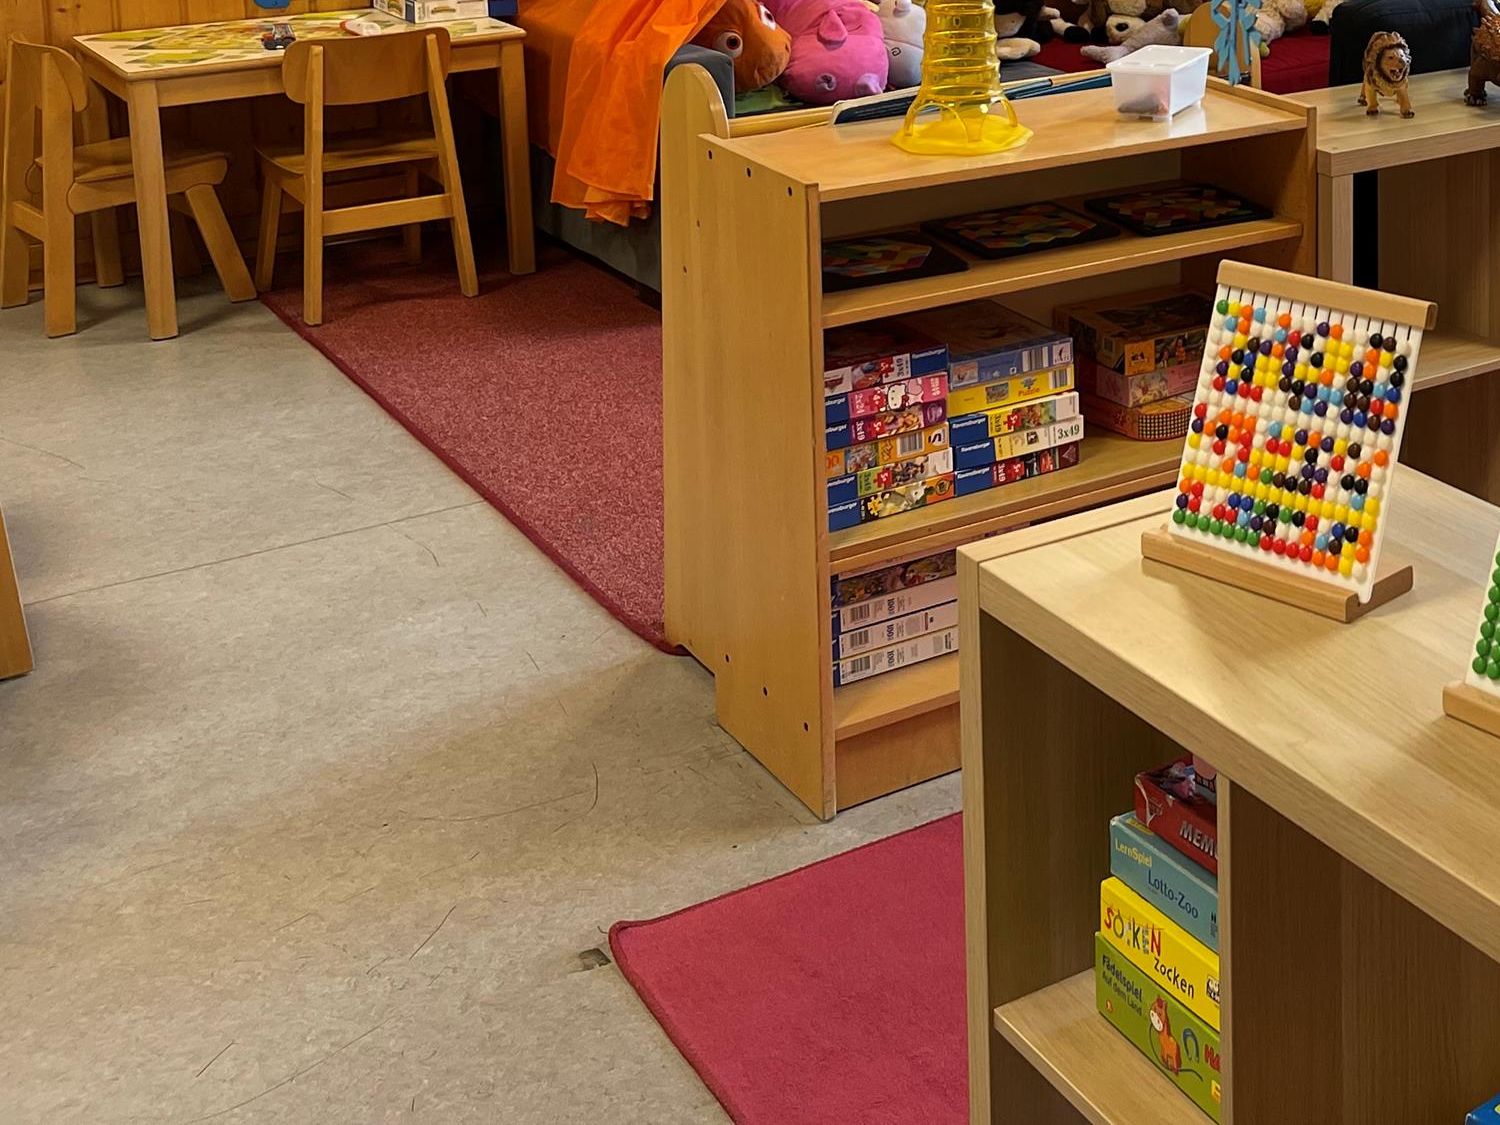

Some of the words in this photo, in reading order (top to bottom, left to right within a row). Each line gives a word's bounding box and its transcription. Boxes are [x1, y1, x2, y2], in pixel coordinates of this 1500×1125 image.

[1057, 423, 1080, 440] 3x49
[1114, 837, 1153, 868] LernSpiel
[1147, 868, 1200, 919] Lotto-Zoo
[1154, 957, 1195, 1000] zocken
